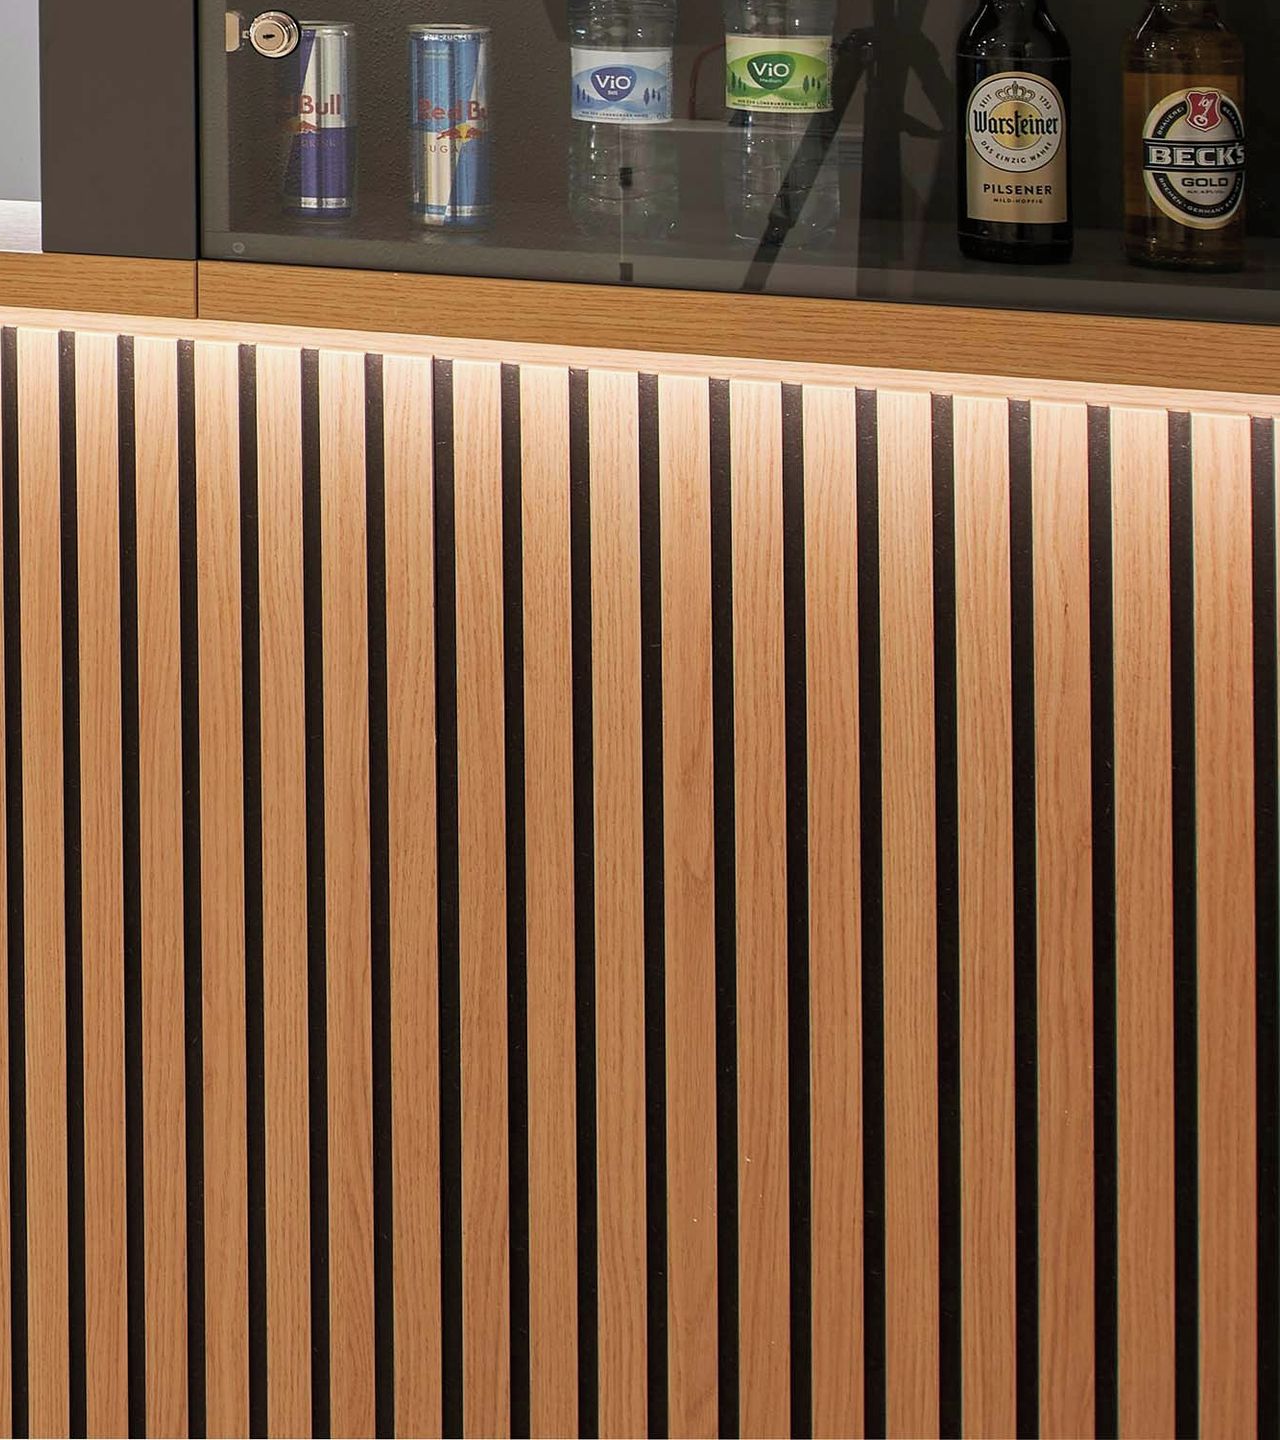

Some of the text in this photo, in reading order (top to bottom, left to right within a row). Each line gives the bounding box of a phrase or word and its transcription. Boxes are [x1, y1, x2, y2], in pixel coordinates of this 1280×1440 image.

[752, 62, 789, 77] ViO
[595, 74, 631, 90] ViO
[299, 94, 341, 115] Bull
[418, 97, 462, 121] Red
[979, 94, 992, 108] SEIT
[973, 110, 1058, 137] Warsteiner
[980, 140, 993, 154] DAS
[996, 153, 1027, 164] EINZIG
[983, 183, 1052, 195] PILSENER
[1181, 177, 1228, 187] GOLD
